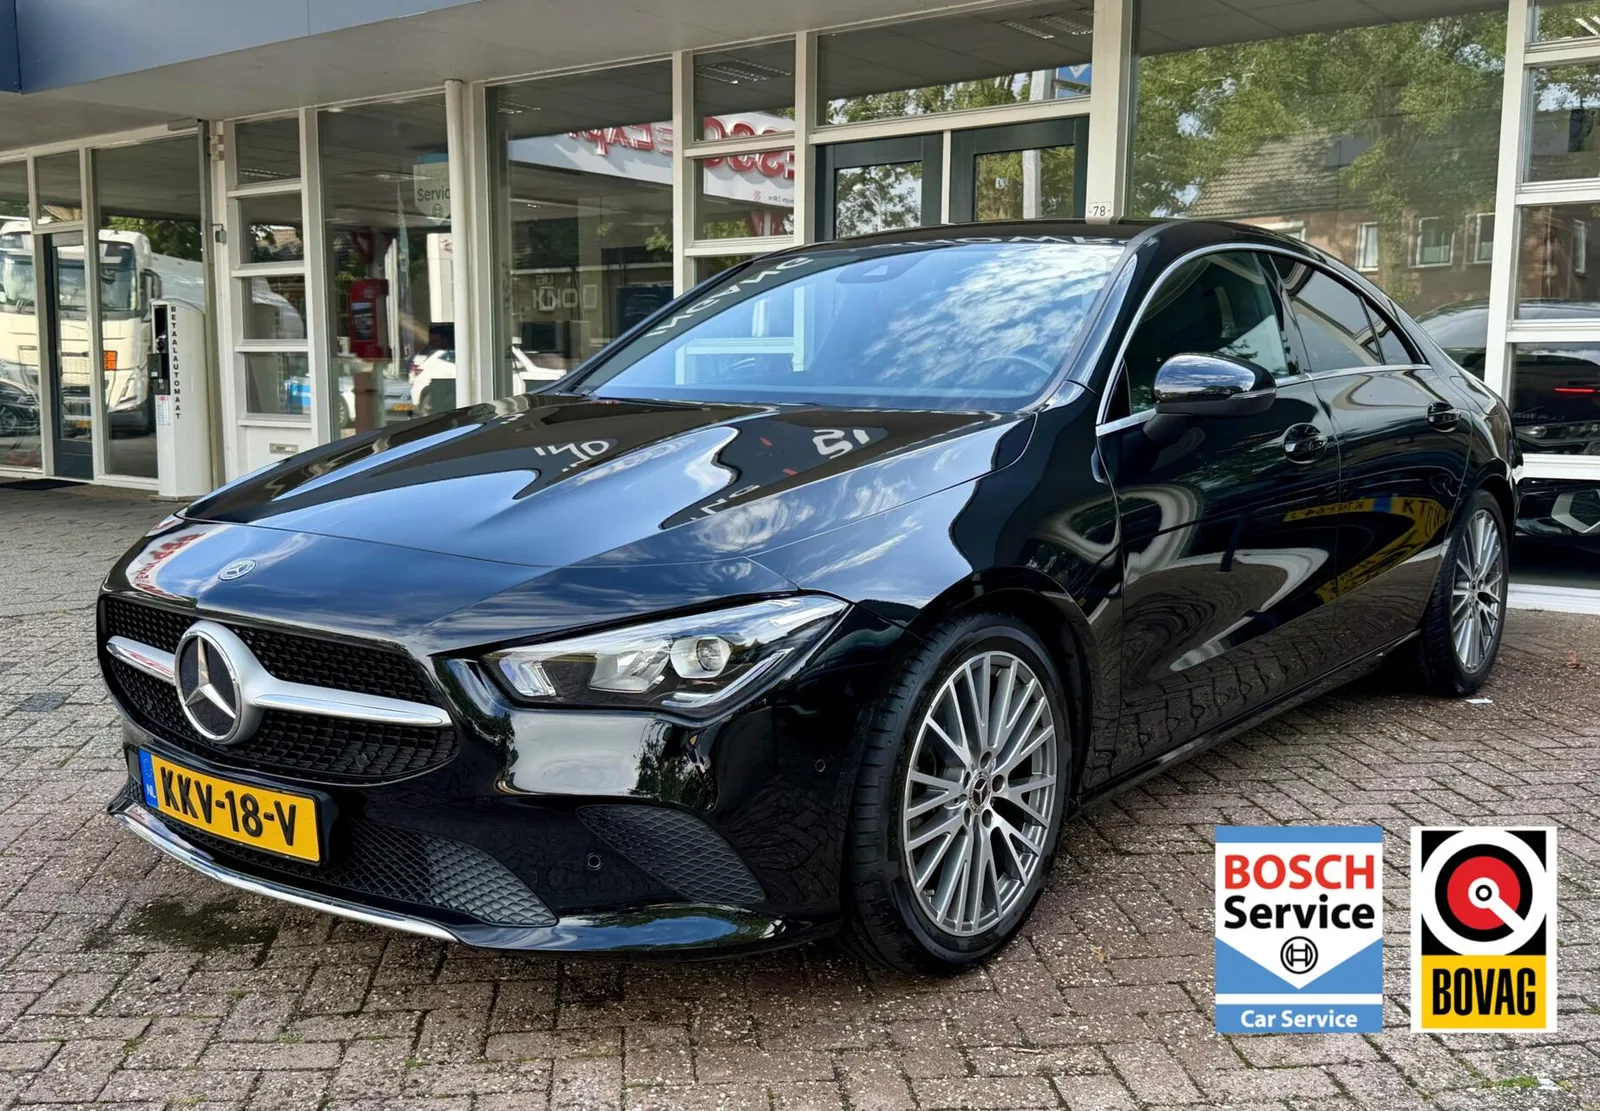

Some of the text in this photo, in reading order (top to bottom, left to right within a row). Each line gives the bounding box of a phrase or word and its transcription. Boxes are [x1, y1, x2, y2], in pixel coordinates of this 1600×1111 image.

[416, 184, 451, 201] Servic
[1092, 205, 1106, 217] 78
[171, 306, 181, 420] BETAALAUTOMAAT
[146, 782, 157, 799] NL
[160, 766, 297, 847] KKV-18-V
